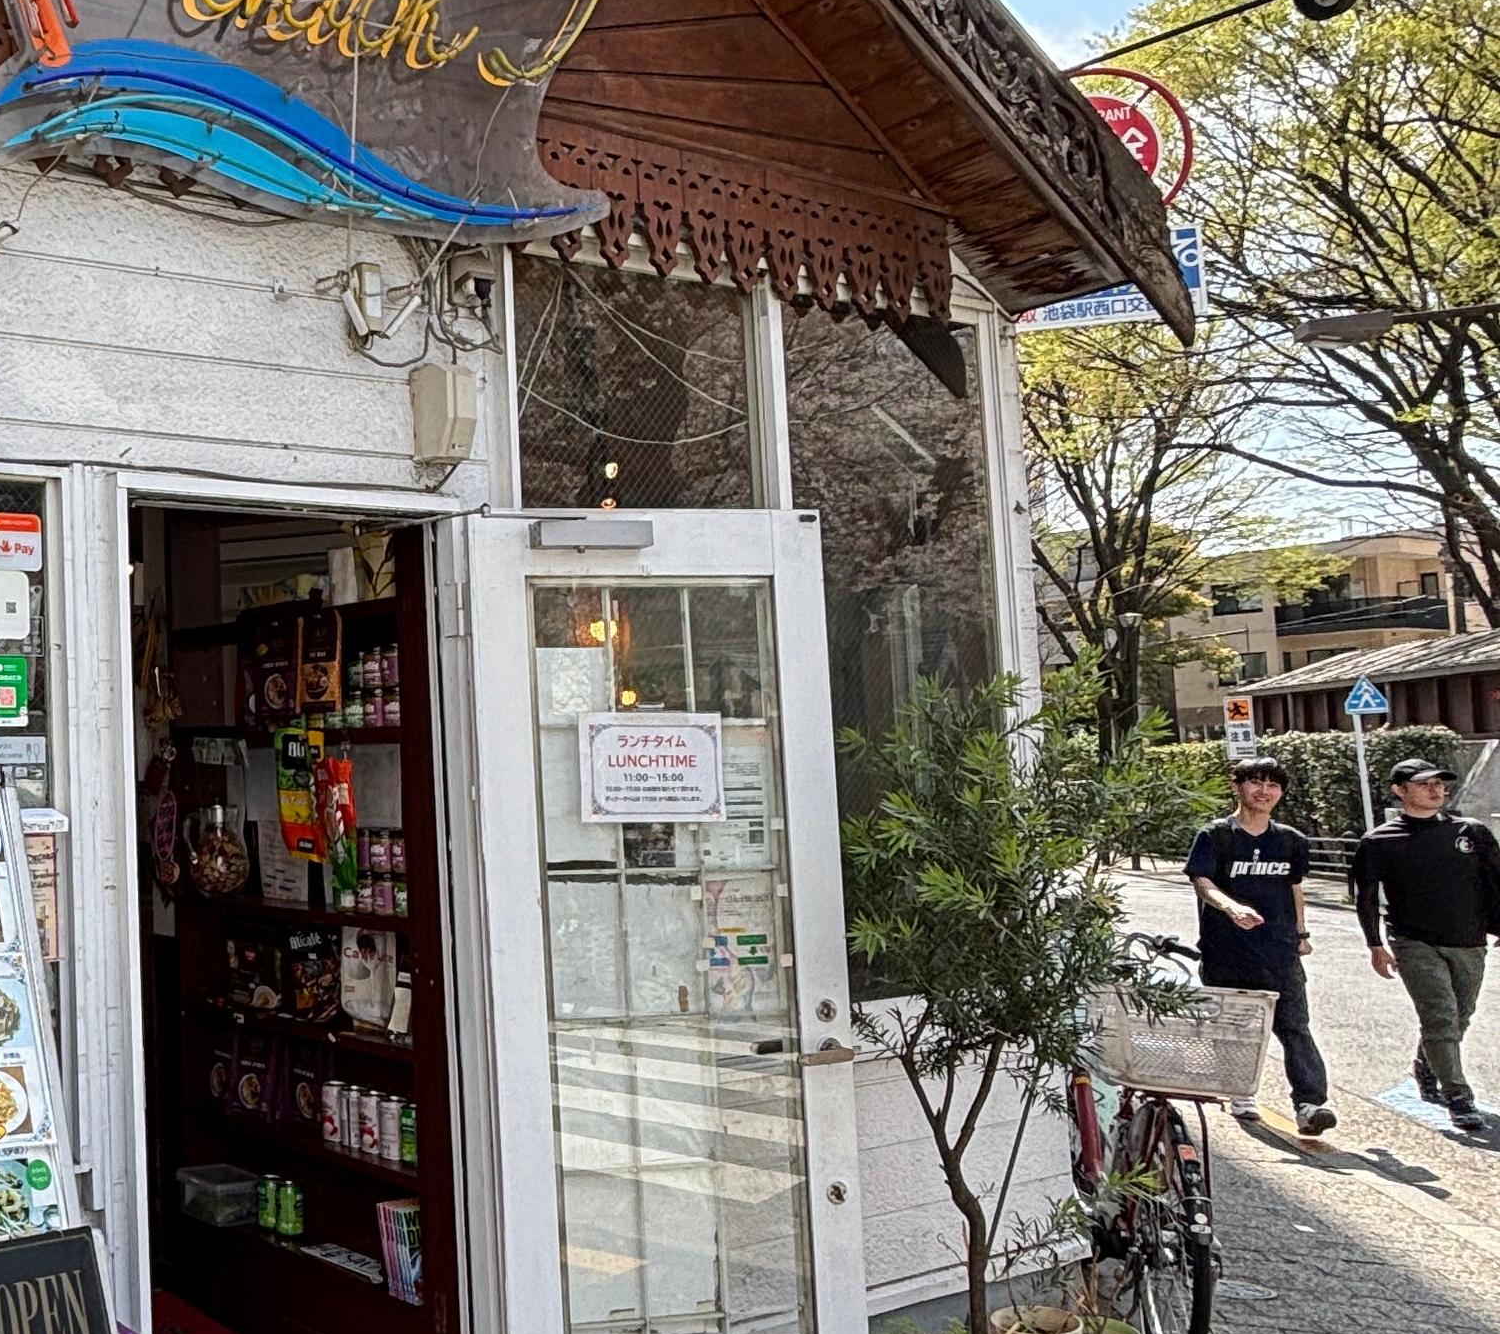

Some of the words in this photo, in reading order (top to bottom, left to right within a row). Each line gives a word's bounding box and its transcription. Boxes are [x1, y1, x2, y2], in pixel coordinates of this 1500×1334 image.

[1042, 296, 1153, 322] 池袋駅西口交
[14, 542, 35, 556] Pay
[617, 735, 687, 748] ランチタイム
[608, 754, 698, 768] LUNCHTIME
[1230, 860, 1291, 879] prince
